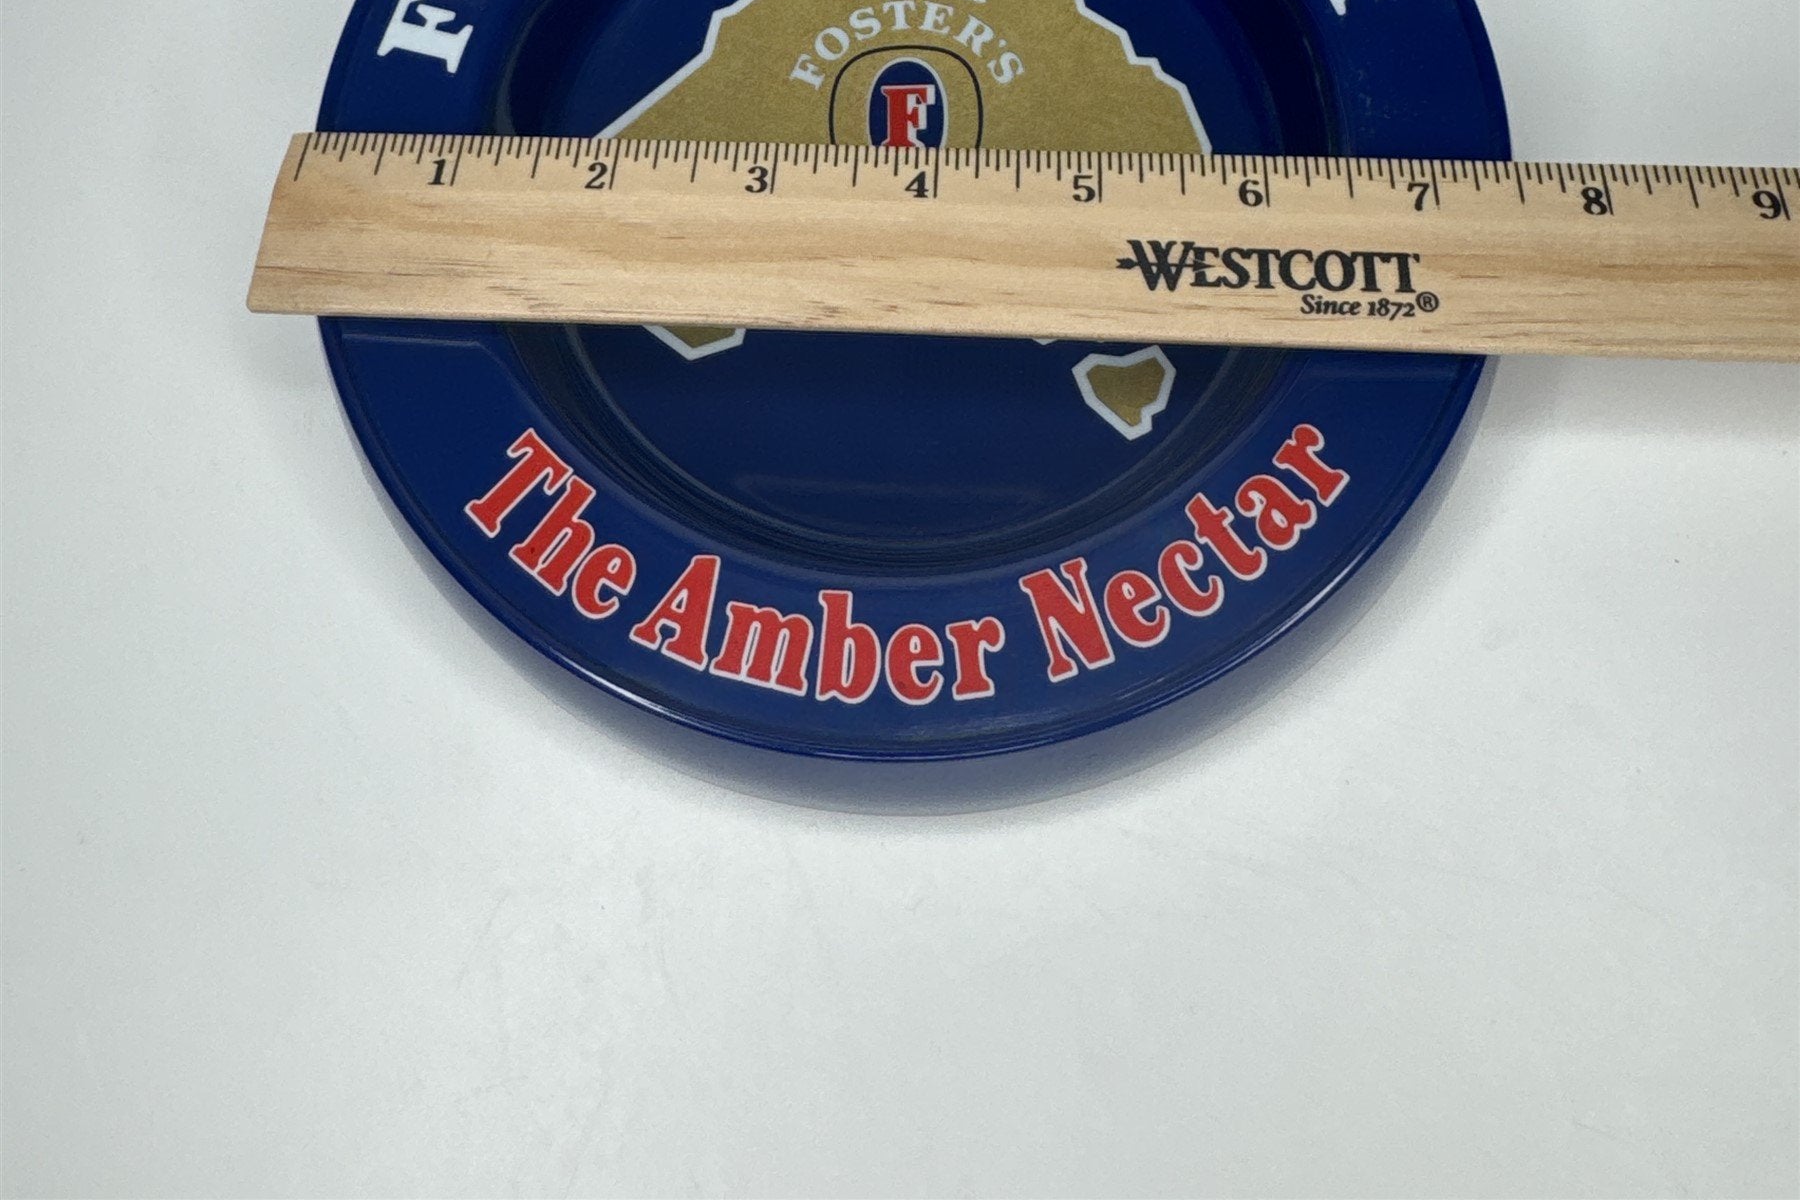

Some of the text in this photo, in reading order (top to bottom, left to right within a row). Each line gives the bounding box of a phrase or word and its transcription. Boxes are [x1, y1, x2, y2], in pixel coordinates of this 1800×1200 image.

[789, 0, 1025, 91] FOSTER'S
[880, 84, 936, 148] F
[427, 158, 1782, 220] 1 2 3 4 5 6 7 8 9
[1116, 239, 1420, 293] WESTCOTT
[1300, 294, 1360, 316] Since
[464, 422, 1351, 706] The Amber Nectar
